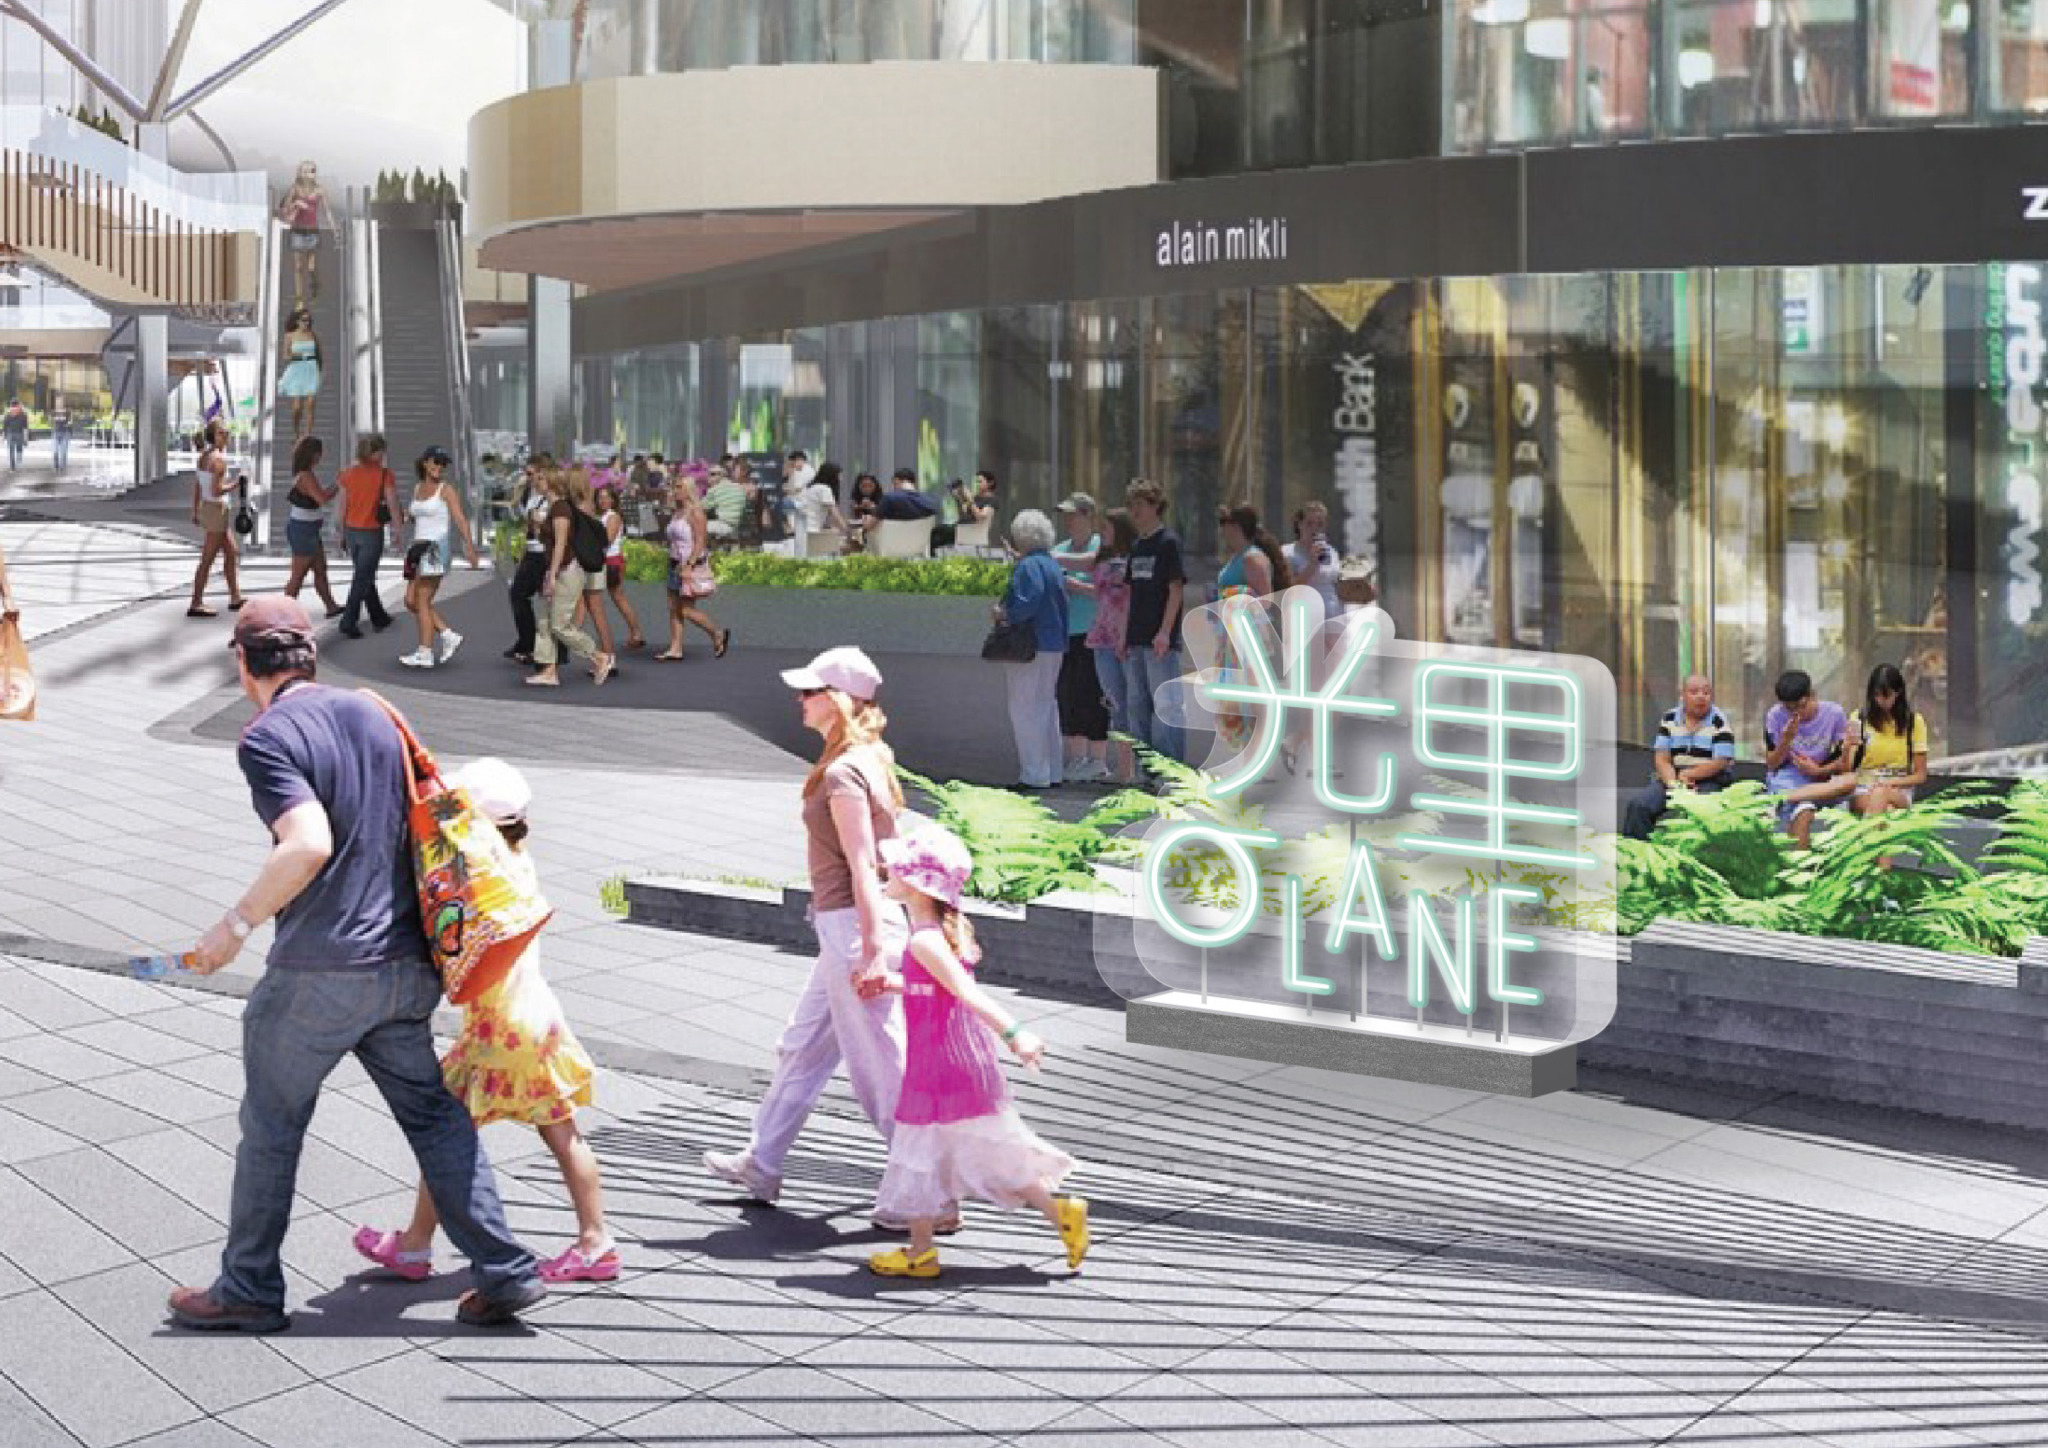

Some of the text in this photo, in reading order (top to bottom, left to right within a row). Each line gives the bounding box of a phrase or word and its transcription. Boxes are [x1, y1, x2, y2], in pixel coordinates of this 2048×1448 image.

[1156, 216, 1287, 266] alain mikli
[1332, 353, 1376, 431] Bank
[1202, 600, 1600, 870] 光里
